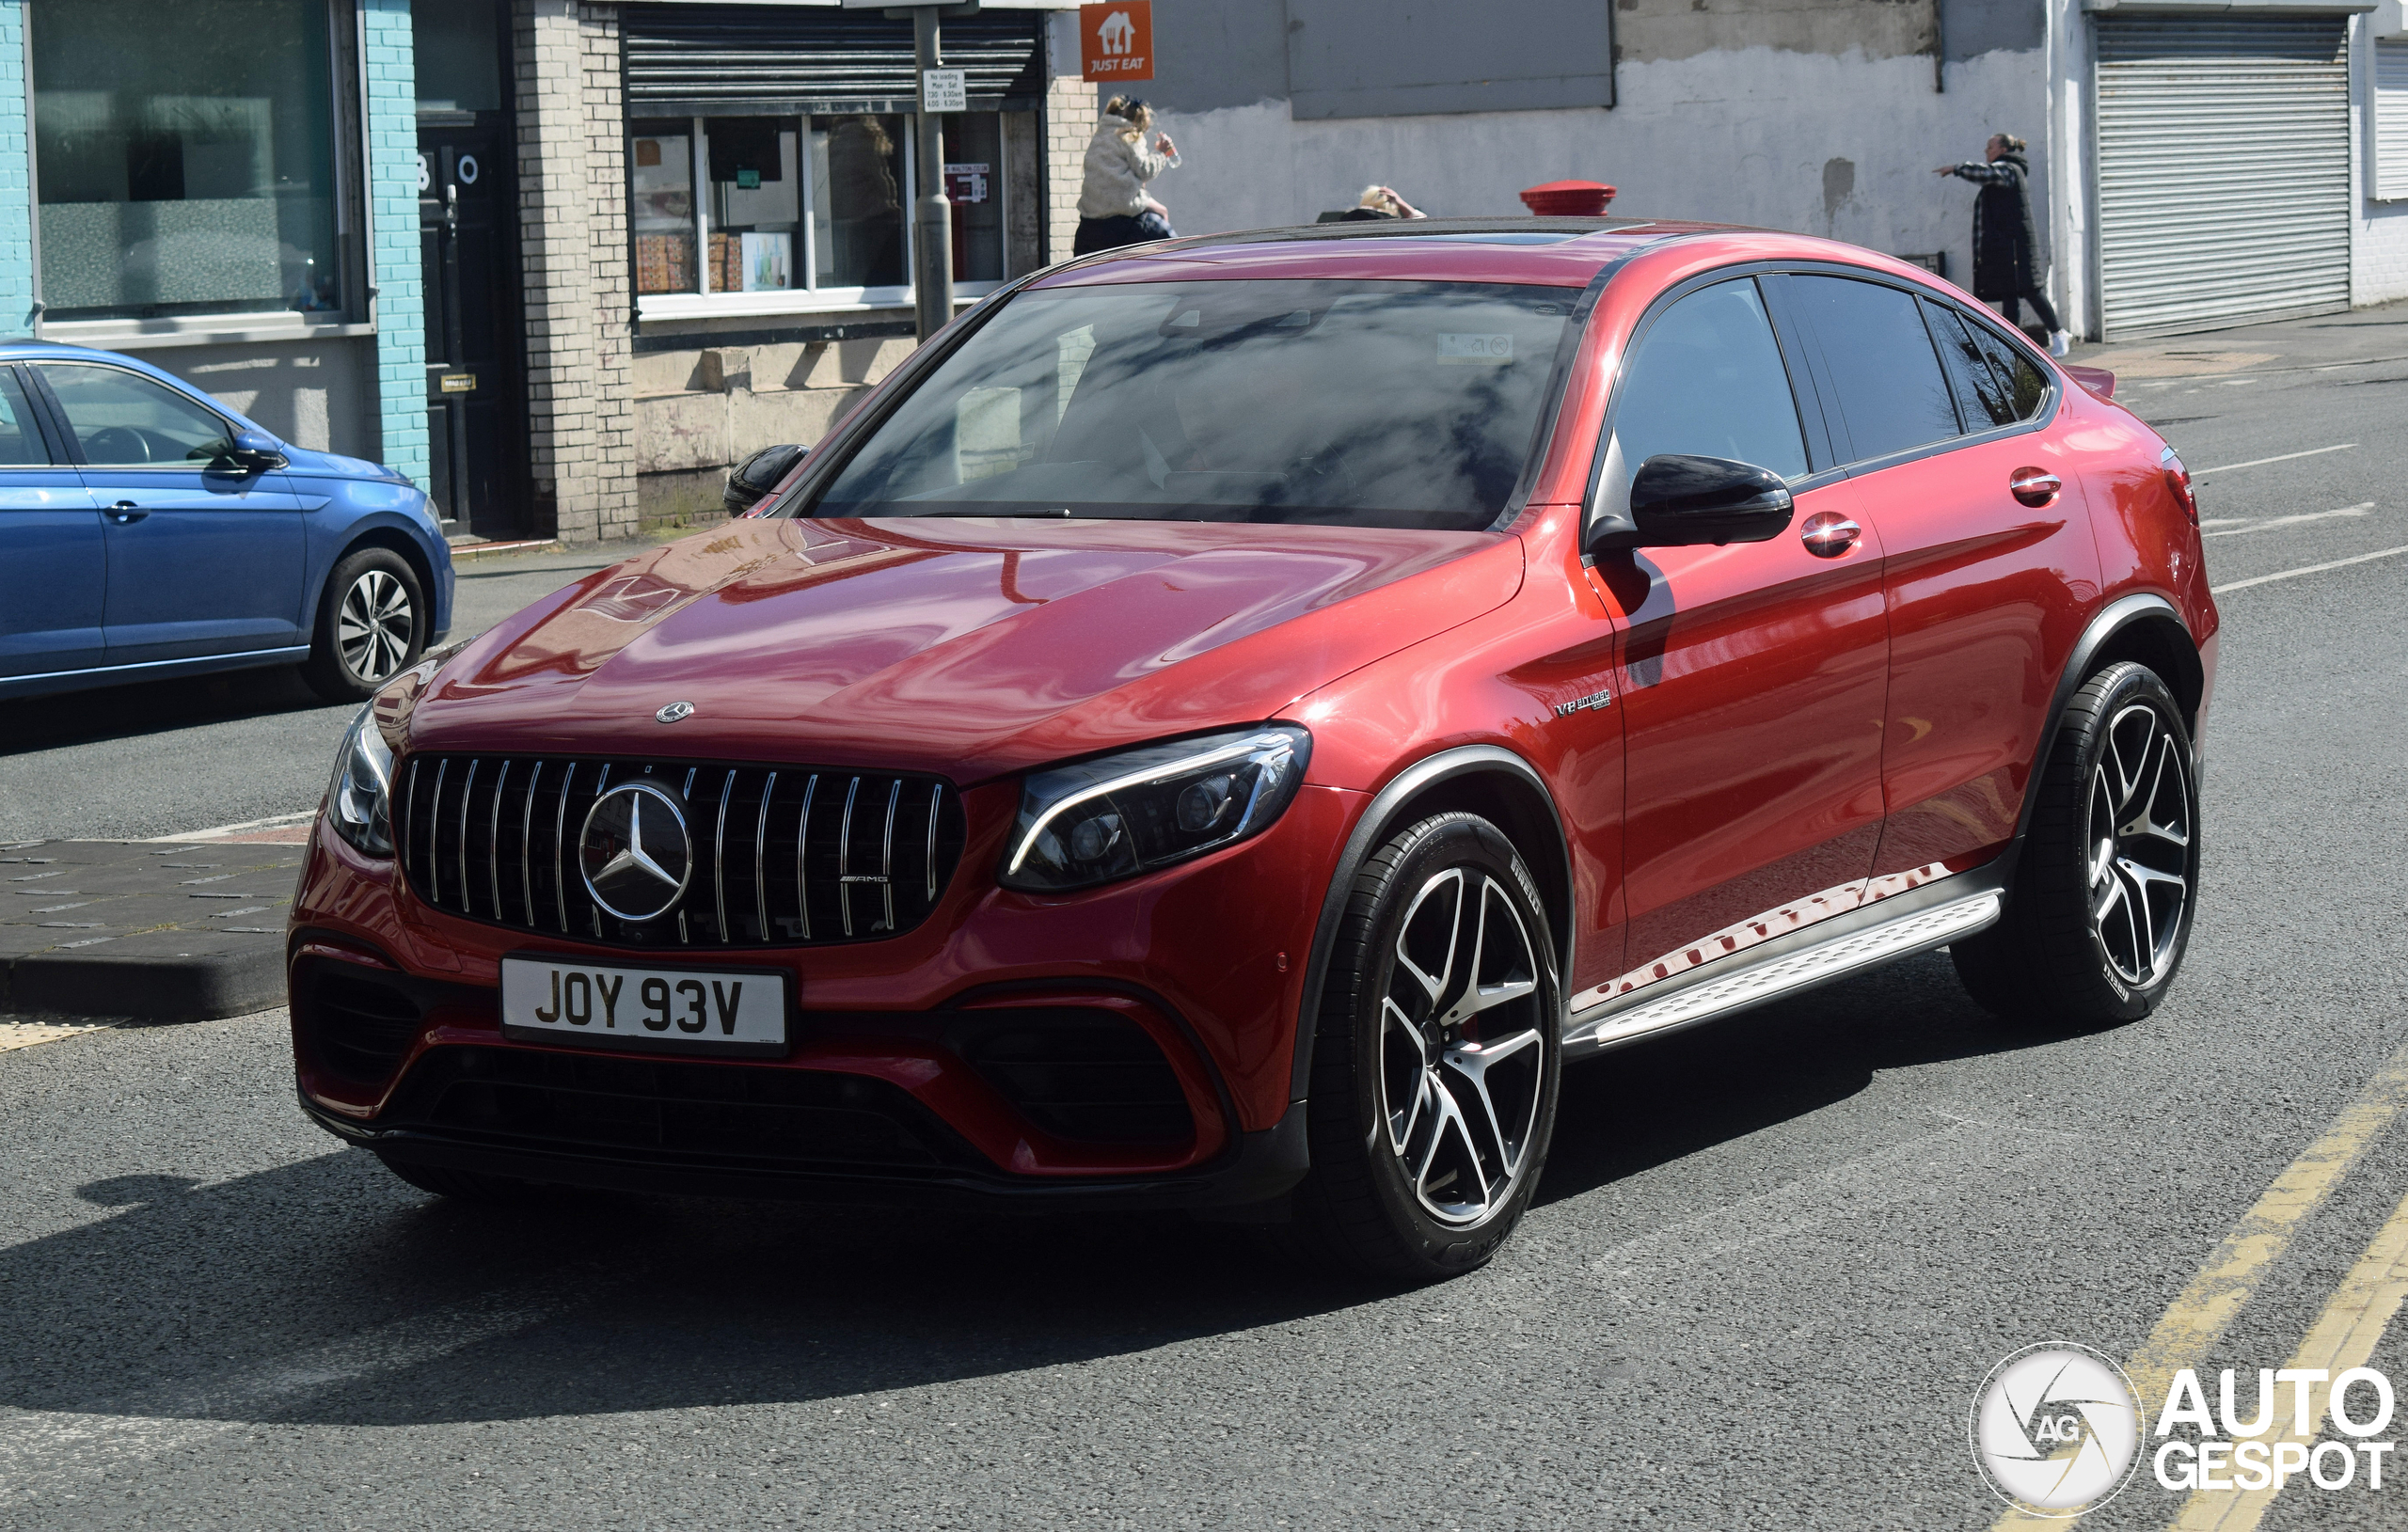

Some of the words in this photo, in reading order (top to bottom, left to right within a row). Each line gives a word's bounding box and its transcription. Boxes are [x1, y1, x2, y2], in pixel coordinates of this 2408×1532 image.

[939, 72, 958, 81] loading
[1090, 58, 1119, 73] JUST
[1121, 57, 1145, 71] EAT
[1554, 701, 1576, 718] V8
[1576, 689, 1609, 708] BITURBO
[1510, 854, 1541, 916] PIRELLI
[2102, 962, 2131, 1004] PIRELLI
[535, 970, 624, 1028] JOY
[641, 977, 743, 1035] 93V
